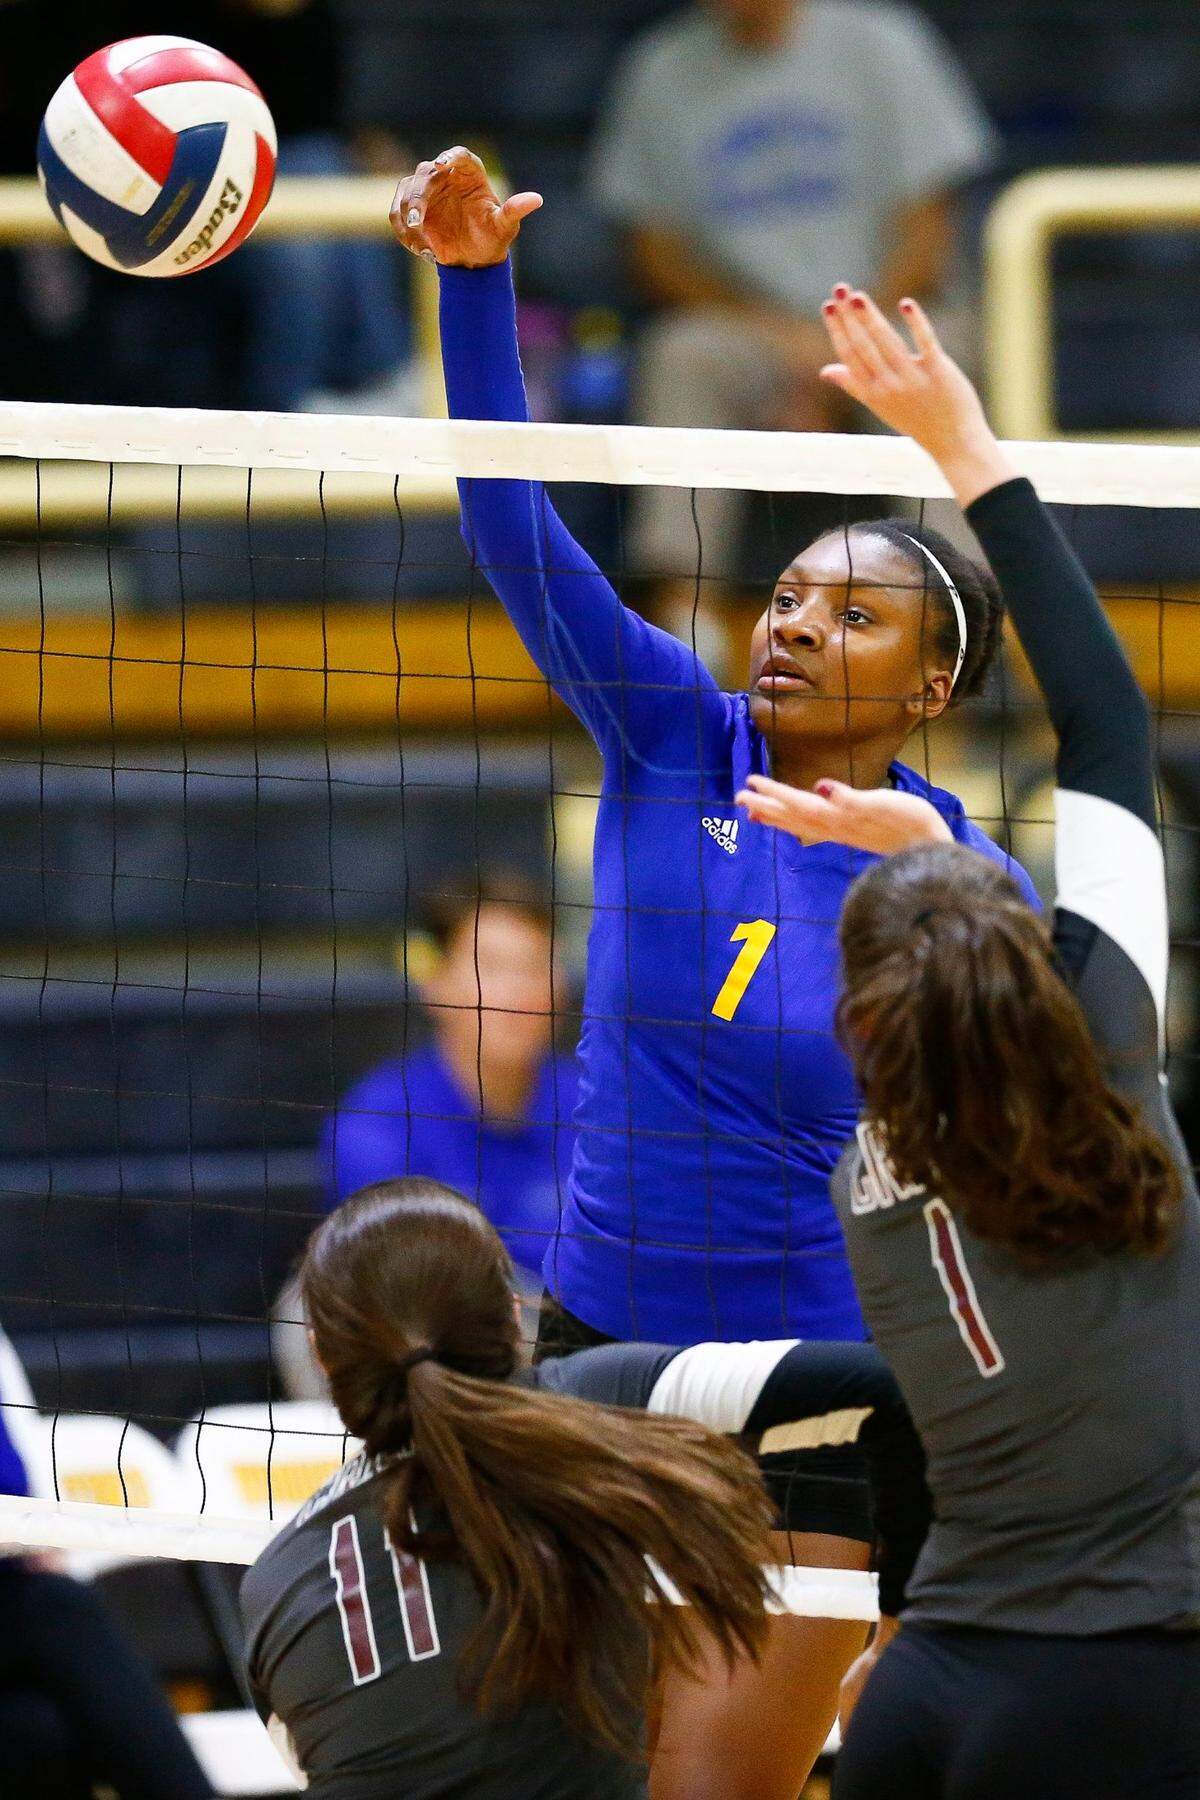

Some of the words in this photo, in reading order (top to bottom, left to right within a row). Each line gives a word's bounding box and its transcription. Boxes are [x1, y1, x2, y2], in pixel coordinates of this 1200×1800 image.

[174, 177, 242, 266] Baden
[701, 817, 738, 855] adidas
[711, 918, 777, 1022] 1
[923, 1197, 1006, 1379] 1
[328, 1514, 441, 1687] 11
